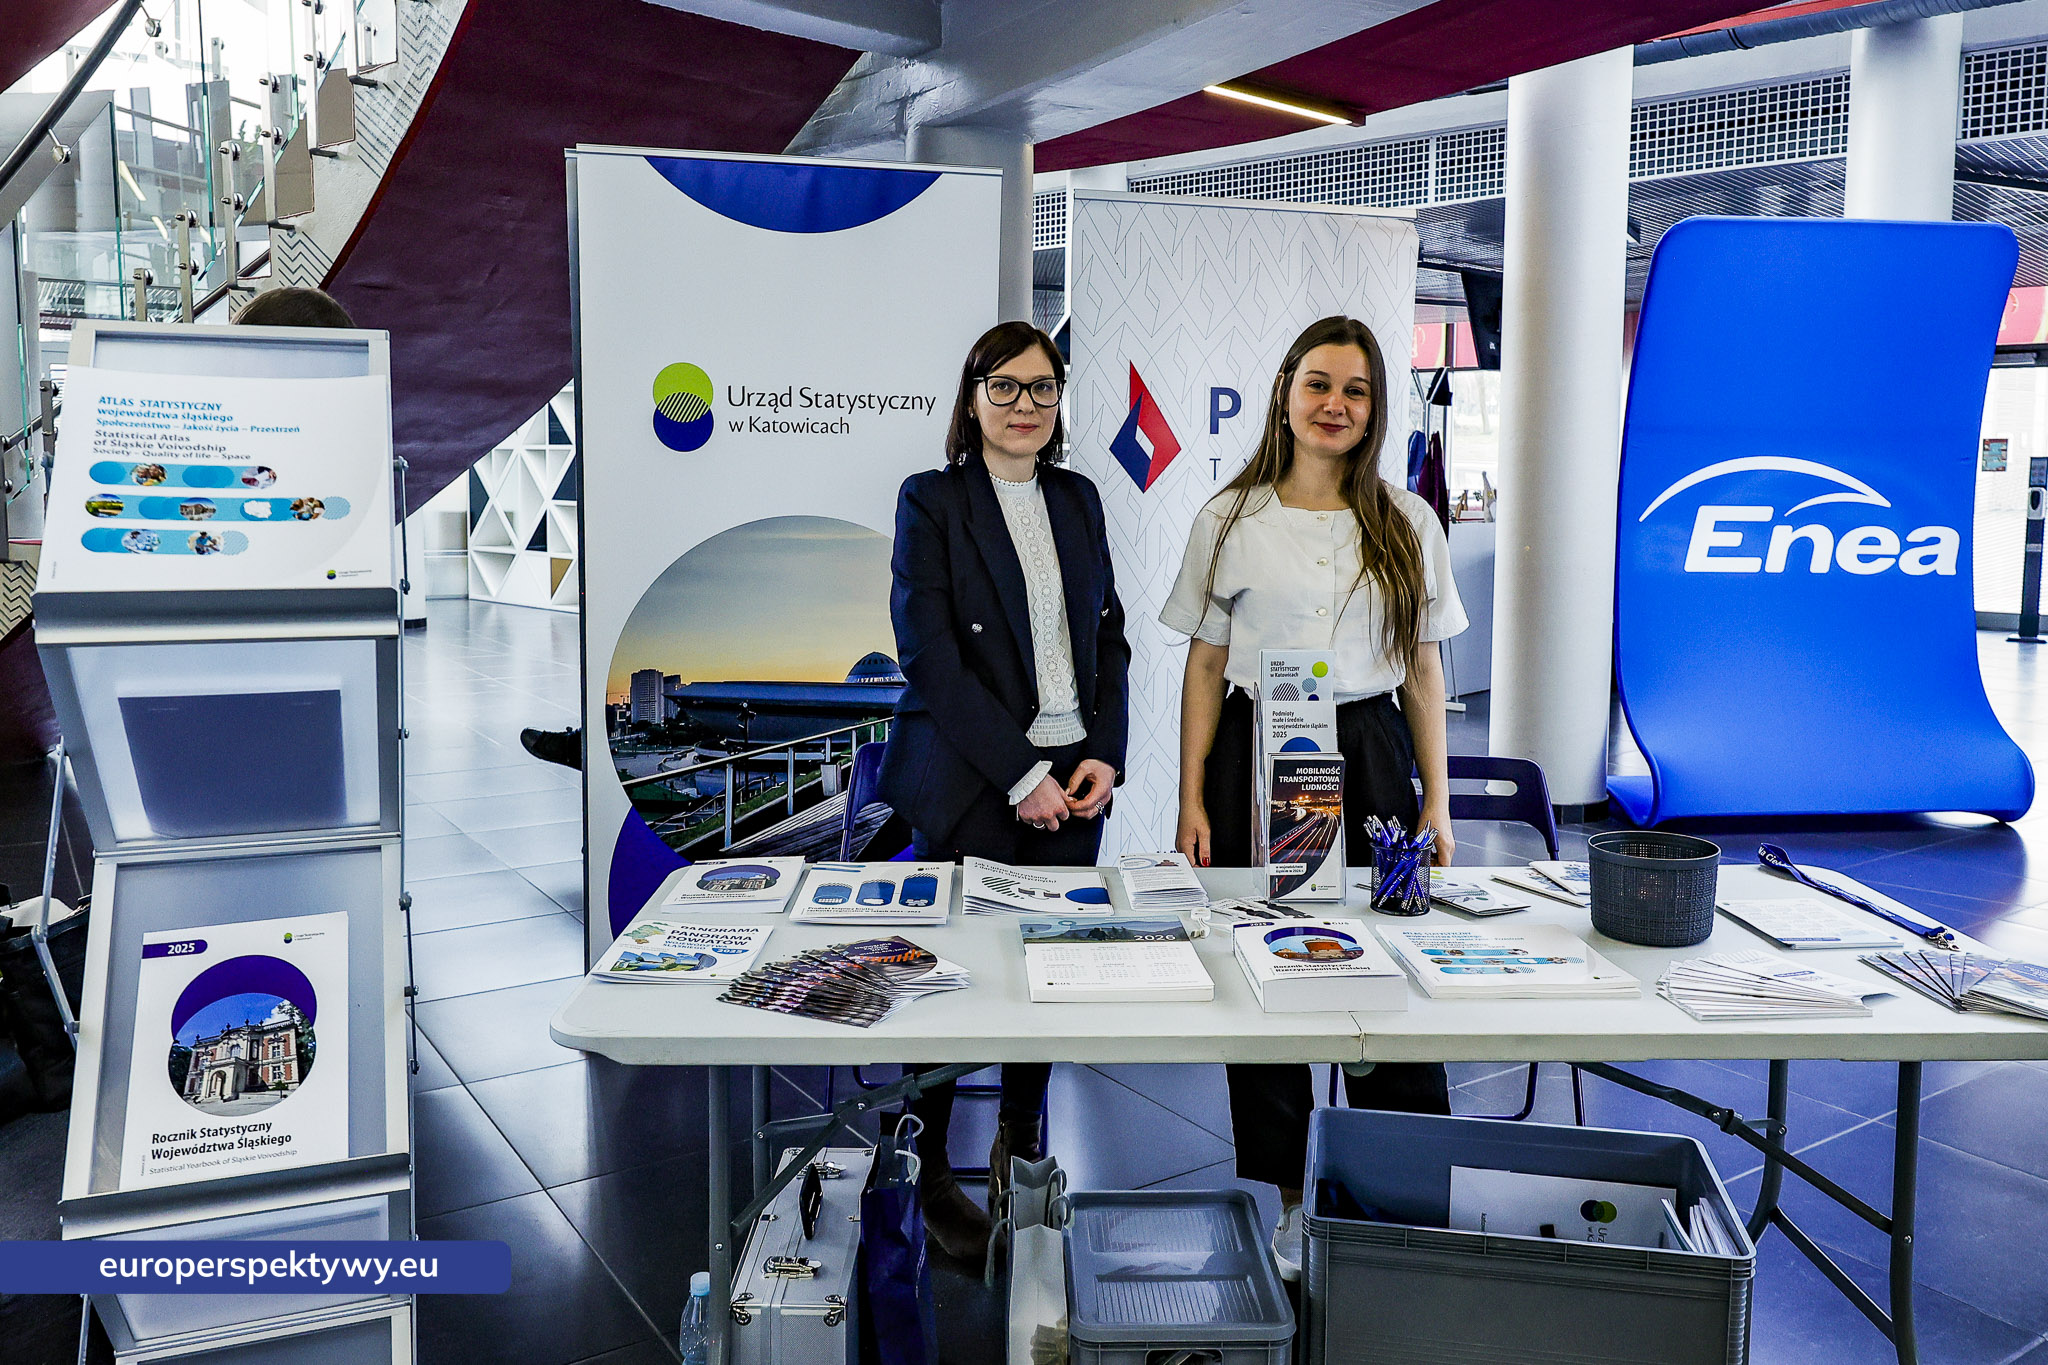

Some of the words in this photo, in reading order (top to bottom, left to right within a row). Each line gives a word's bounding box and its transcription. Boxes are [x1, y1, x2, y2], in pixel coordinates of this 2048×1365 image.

[98, 396, 134, 406] ATLAS
[140, 399, 222, 411] STATYSTYCZNY
[727, 385, 792, 414] Urząd
[799, 387, 937, 416] Statystyczny
[97, 407, 178, 420] województwa
[181, 412, 234, 423] śląskiego
[96, 418, 171, 430] Społeczeństwo
[182, 423, 213, 431] Jakość
[215, 424, 239, 433] życia
[250, 425, 300, 433] Przestrzeń
[729, 420, 744, 433] w
[750, 416, 850, 434] Katowicach
[94, 429, 156, 440] Statistical
[160, 433, 190, 442] Atlas
[93, 447, 131, 457] Society
[142, 450, 180, 459] Quality
[182, 451, 193, 459] of
[195, 451, 212, 459] life
[110, 438, 154, 449] Śląskie
[158, 442, 227, 453] Voivodship
[1684, 505, 1960, 576] Enea
[1295, 766, 1341, 775] MOBILNOŚĆ
[1279, 775, 1340, 783] TRANSPORTOWA
[1301, 782, 1339, 791] LUDNOŚCI
[667, 935, 748, 946] POWIATÓW
[671, 929, 752, 941] PANORAMA
[167, 943, 195, 954] 2025
[152, 1129, 197, 1144] Rocznik
[200, 1122, 273, 1139] Statystyczny
[151, 1140, 235, 1160] Województwa
[237, 1134, 292, 1150] Śląskiego
[149, 1163, 186, 1175] Statistical
[187, 1159, 221, 1170] Yearbook
[222, 1157, 230, 1165] of
[231, 1155, 257, 1164] Śląskie
[257, 1149, 298, 1161] Voivodship
